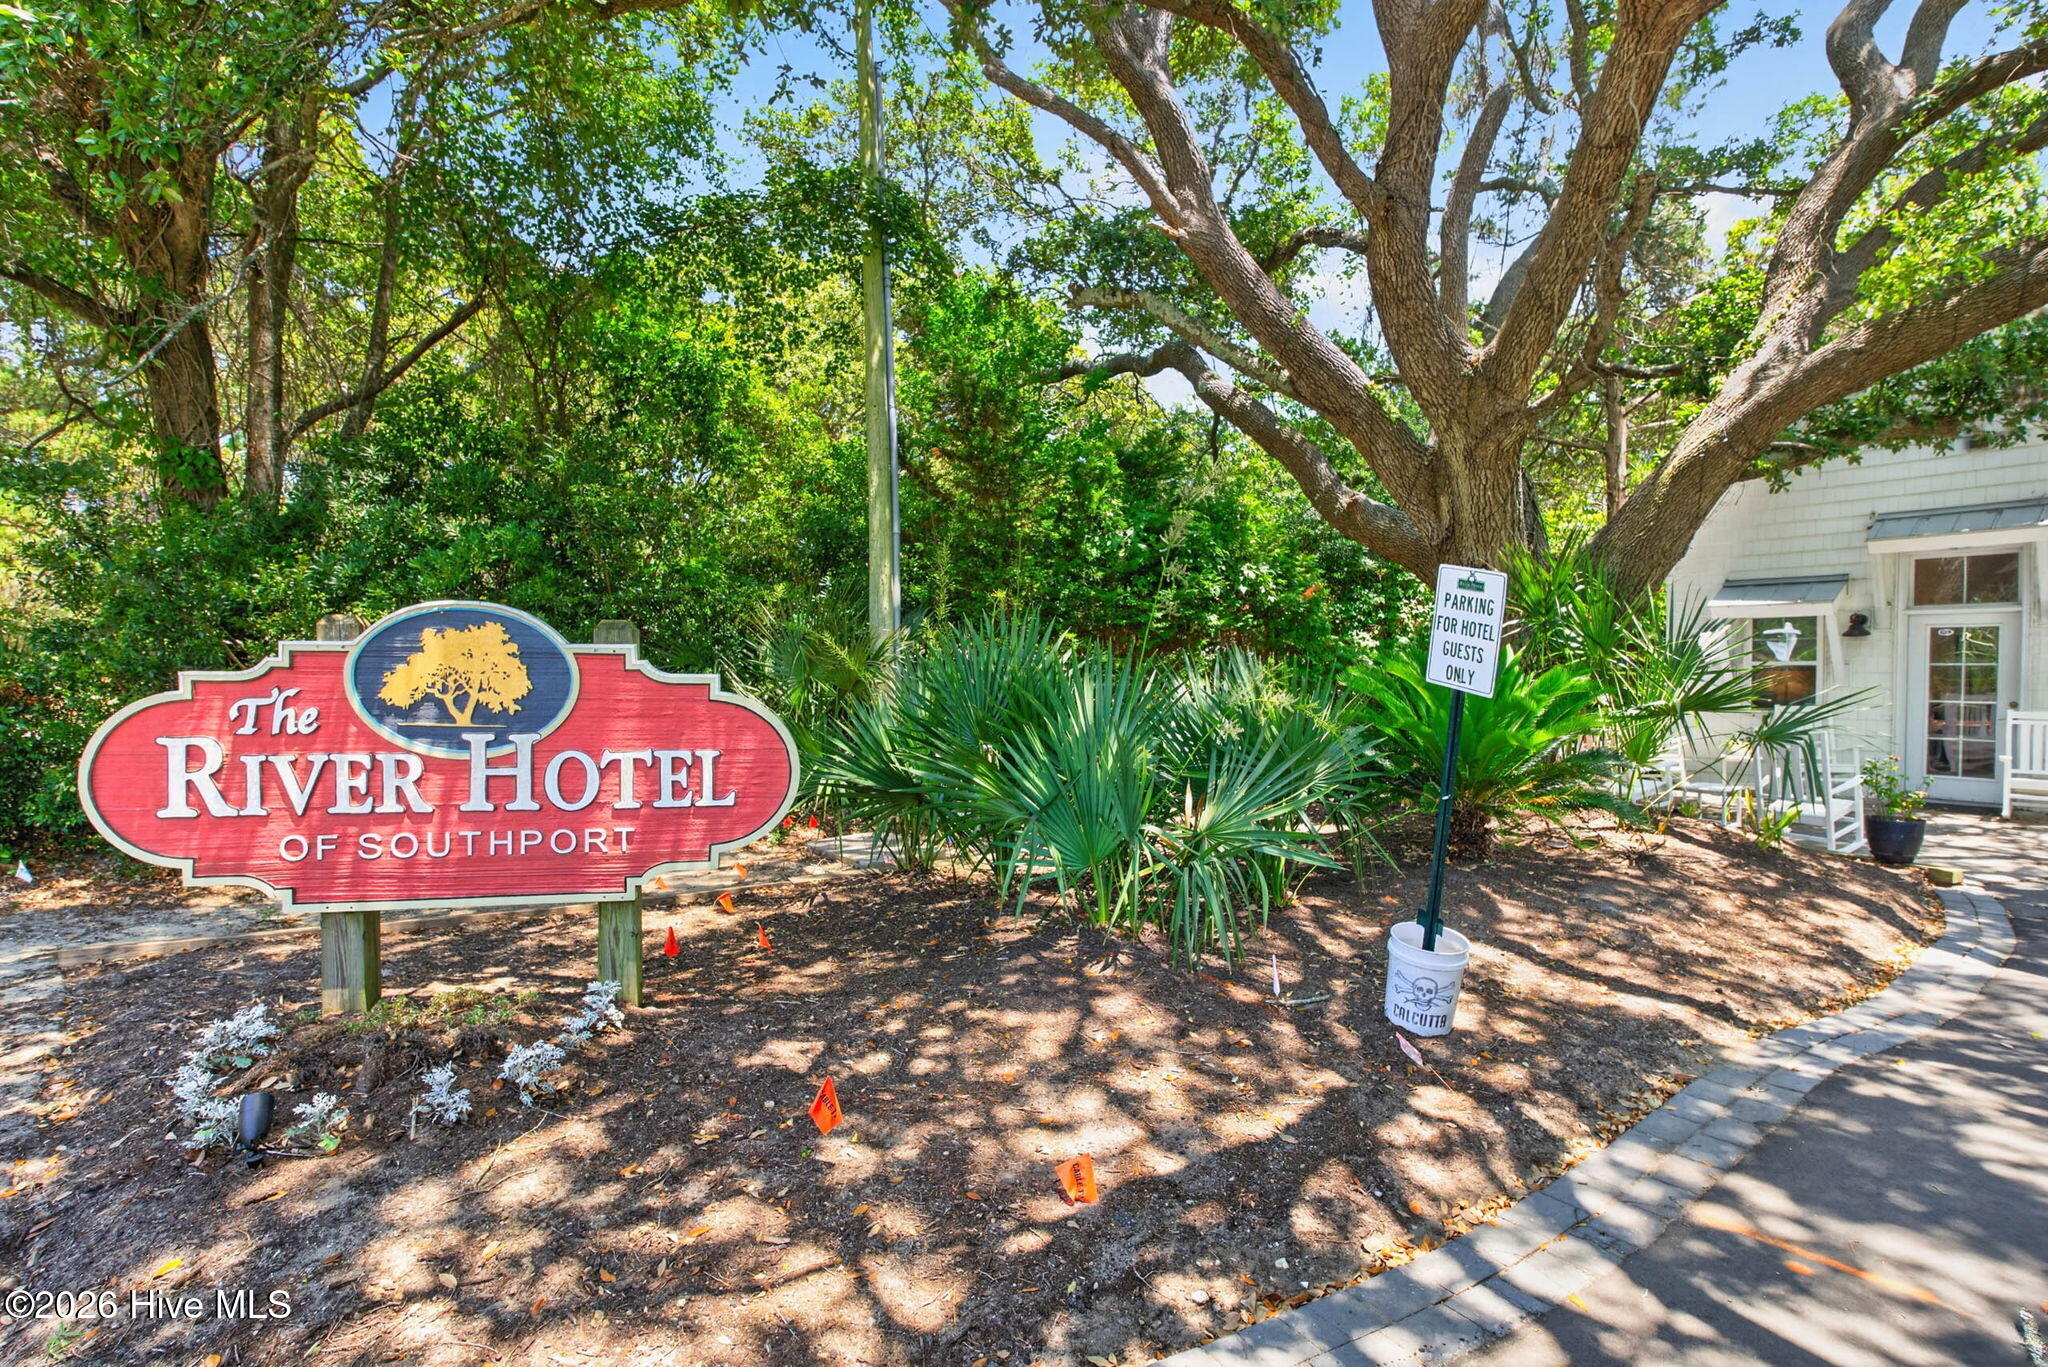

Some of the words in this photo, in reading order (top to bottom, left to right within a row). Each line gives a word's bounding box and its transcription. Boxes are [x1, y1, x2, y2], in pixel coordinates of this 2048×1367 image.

[1444, 593, 1494, 616] PARKING
[1436, 615, 1458, 634] FOR
[1461, 620, 1495, 642] HOTEL
[1442, 640, 1484, 664] GUESTS
[1446, 665, 1475, 686] ONLY
[229, 687, 320, 735] The
[155, 736, 435, 818] RIVER
[459, 733, 737, 812] HOTEL
[279, 834, 339, 862] OF
[358, 827, 635, 860] SOUTHPORT
[1393, 1004, 1447, 1028] CALCUTTA
